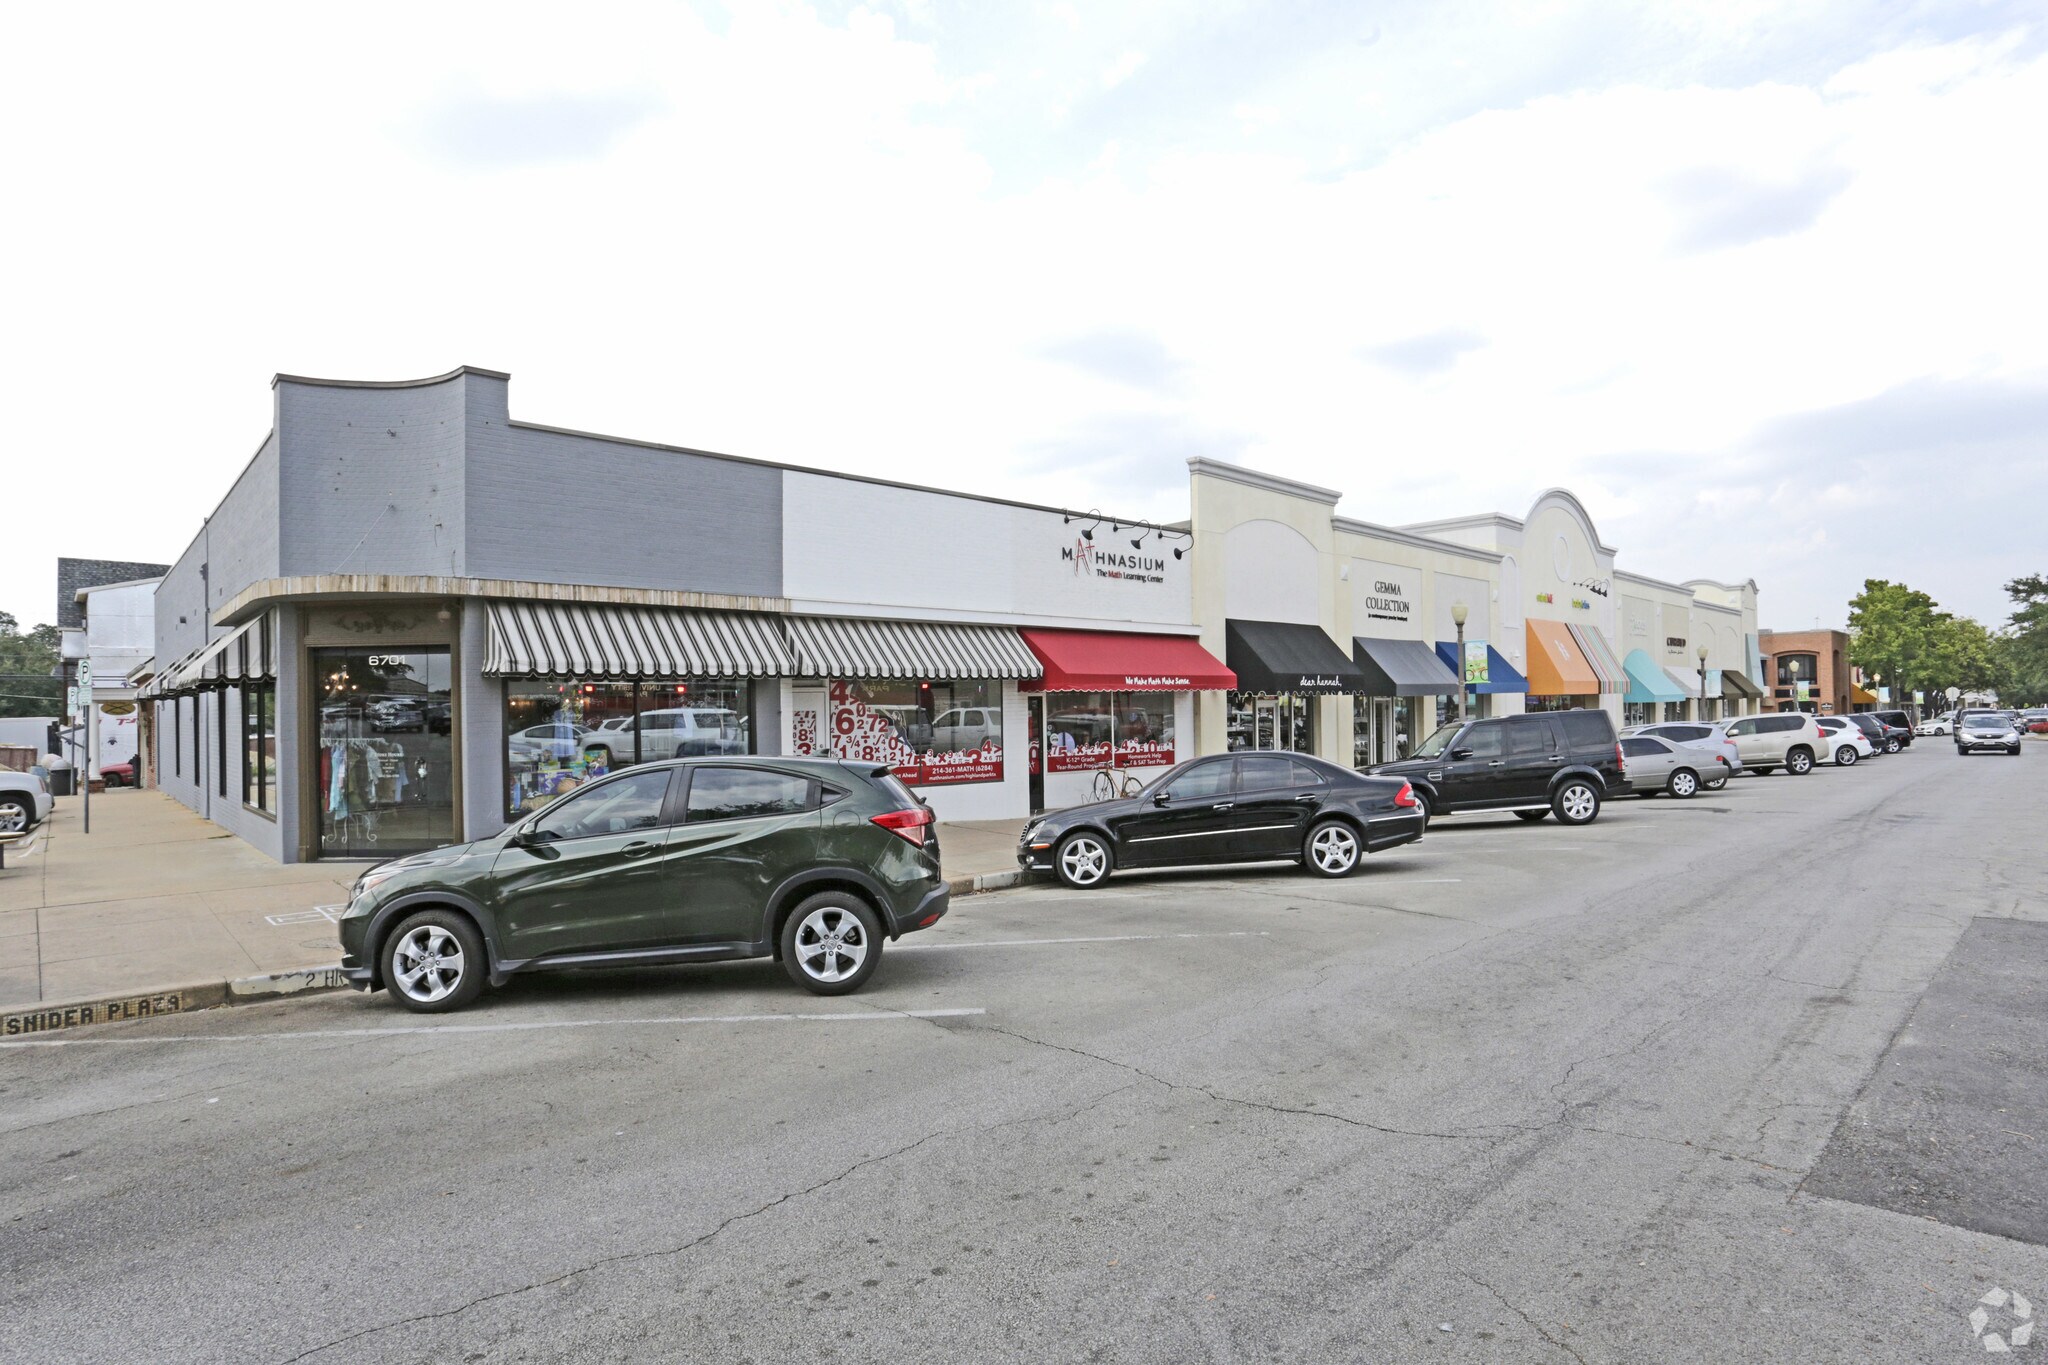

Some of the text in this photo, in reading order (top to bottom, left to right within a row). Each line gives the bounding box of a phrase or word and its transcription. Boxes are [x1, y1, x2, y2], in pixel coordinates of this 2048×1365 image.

[1061, 538, 1164, 577] MATHNASIUM
[1097, 569, 1164, 583] The Math Learning Center
[1374, 580, 1402, 596] GEMMA
[1365, 596, 1410, 613] COLLECTION
[368, 655, 406, 666] 6701
[1125, 676, 1133, 685] We
[1134, 676, 1147, 685] Make
[1148, 676, 1161, 685] Math
[1162, 676, 1174, 685] Make
[1300, 675, 1316, 686] dear
[836, 708, 855, 735] 6
[798, 729, 808, 741] 8
[832, 735, 841, 748] 7
[932, 766, 974, 775] 214-361-MATH
[305, 972, 316, 987] 2
[7, 995, 180, 1035] SNIDER PLAZA
